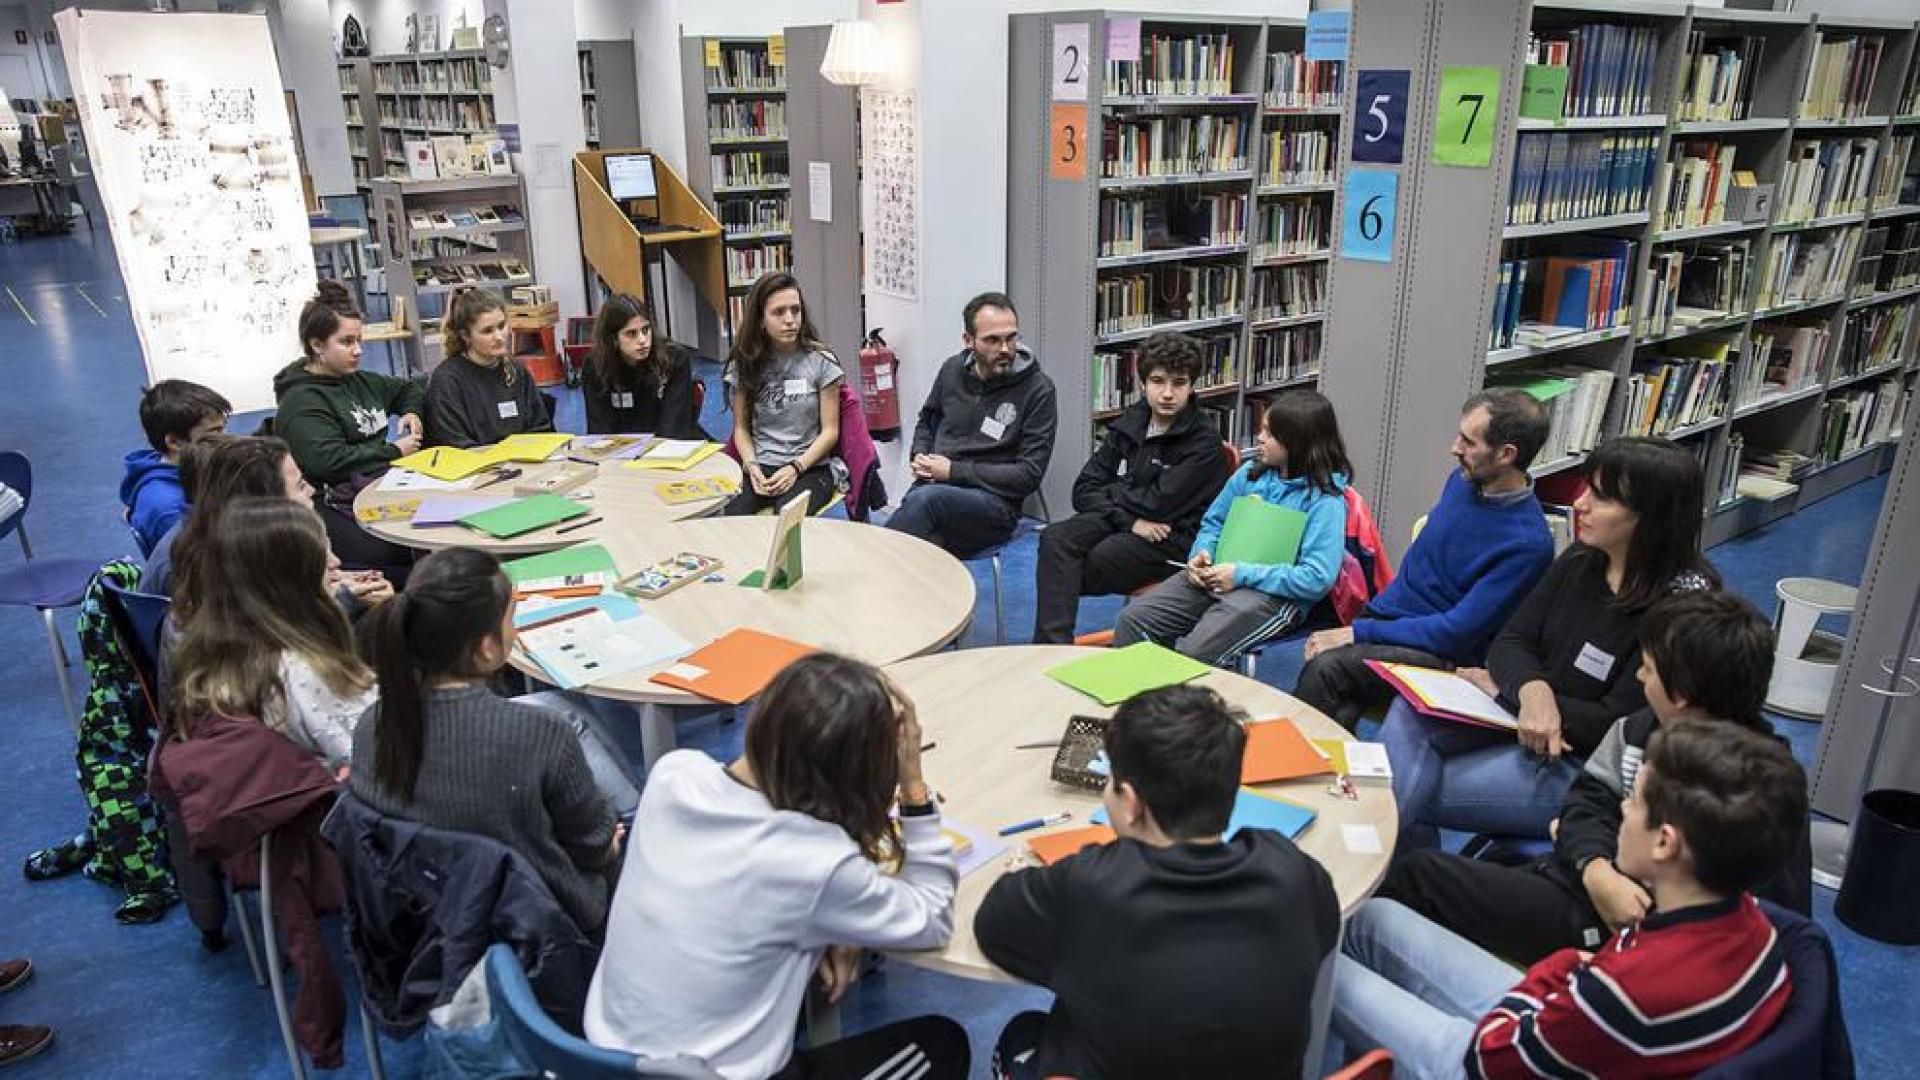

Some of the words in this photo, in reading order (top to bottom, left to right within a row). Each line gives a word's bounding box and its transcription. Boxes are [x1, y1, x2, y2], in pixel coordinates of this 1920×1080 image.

[1063, 44, 1080, 84] 2
[1364, 94, 1391, 143] 5
[1457, 94, 1485, 145] 7
[1061, 124, 1077, 163] 3
[1359, 195, 1383, 241] 6
